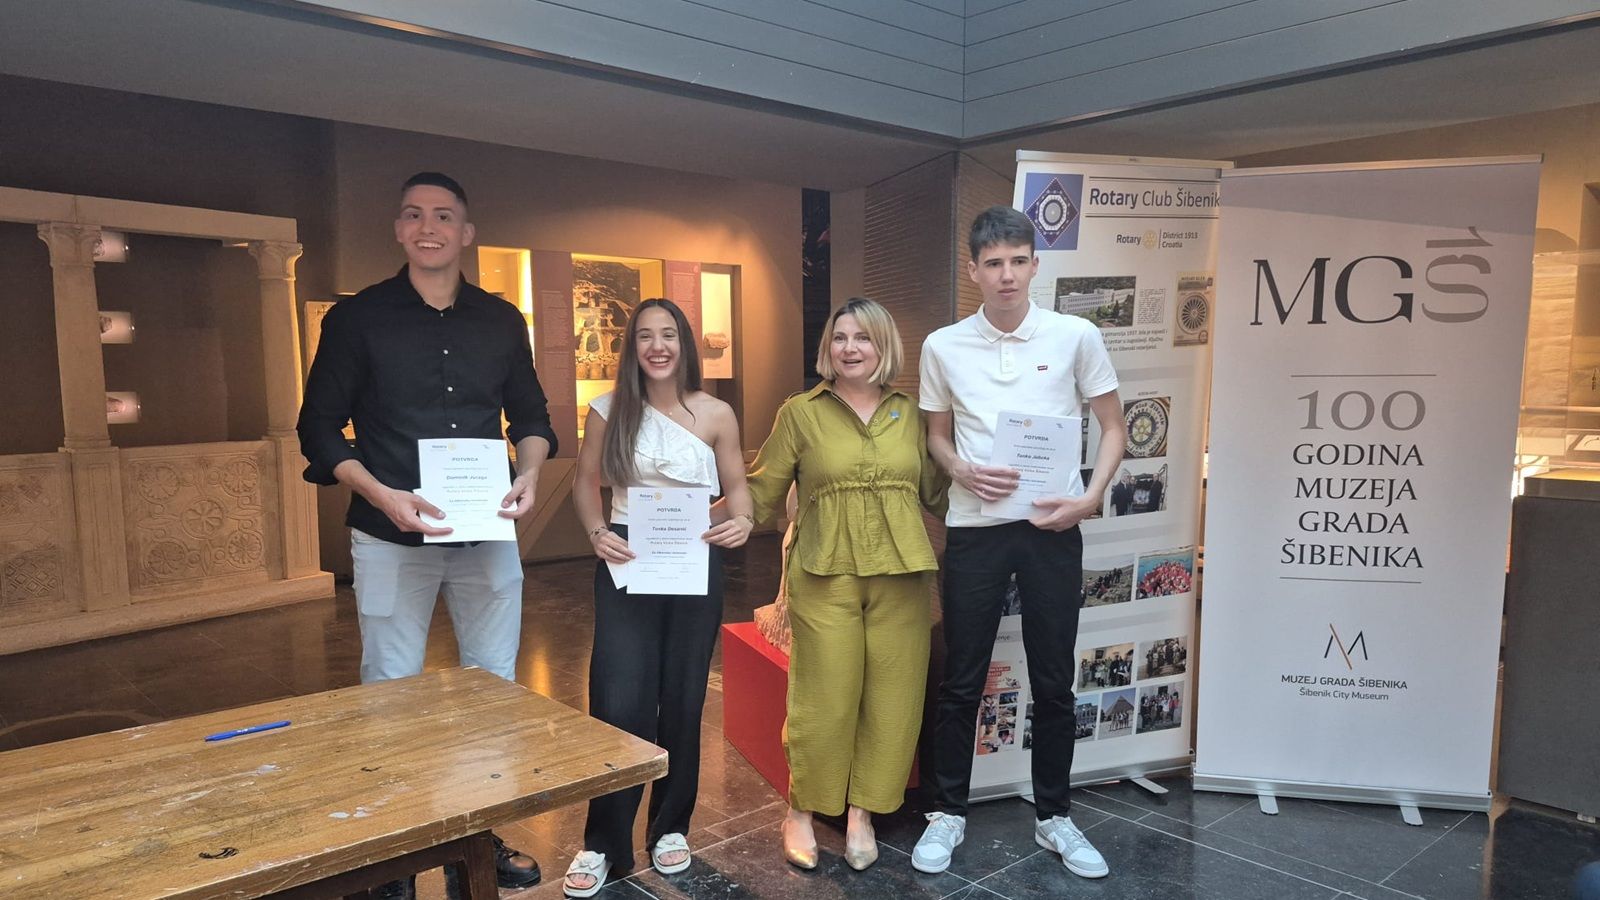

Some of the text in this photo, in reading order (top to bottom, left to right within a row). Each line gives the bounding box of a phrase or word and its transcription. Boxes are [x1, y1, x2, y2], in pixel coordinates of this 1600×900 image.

[1089, 187, 1220, 210] Rotary Club Šibenik
[1116, 234, 1141, 246] Rotary
[1162, 231, 1184, 240] District
[1297, 390, 1426, 431] 100
[1292, 443, 1424, 466] GODINA
[1294, 477, 1418, 508] MUZEJA
[1298, 510, 1410, 534] GRADA
[1280, 538, 1424, 568] ŠIBENIKA
[1281, 674, 1408, 690] MUZEJ GRADA ŠIBENIKA
[1299, 687, 1389, 700] Šibenik City Museum
